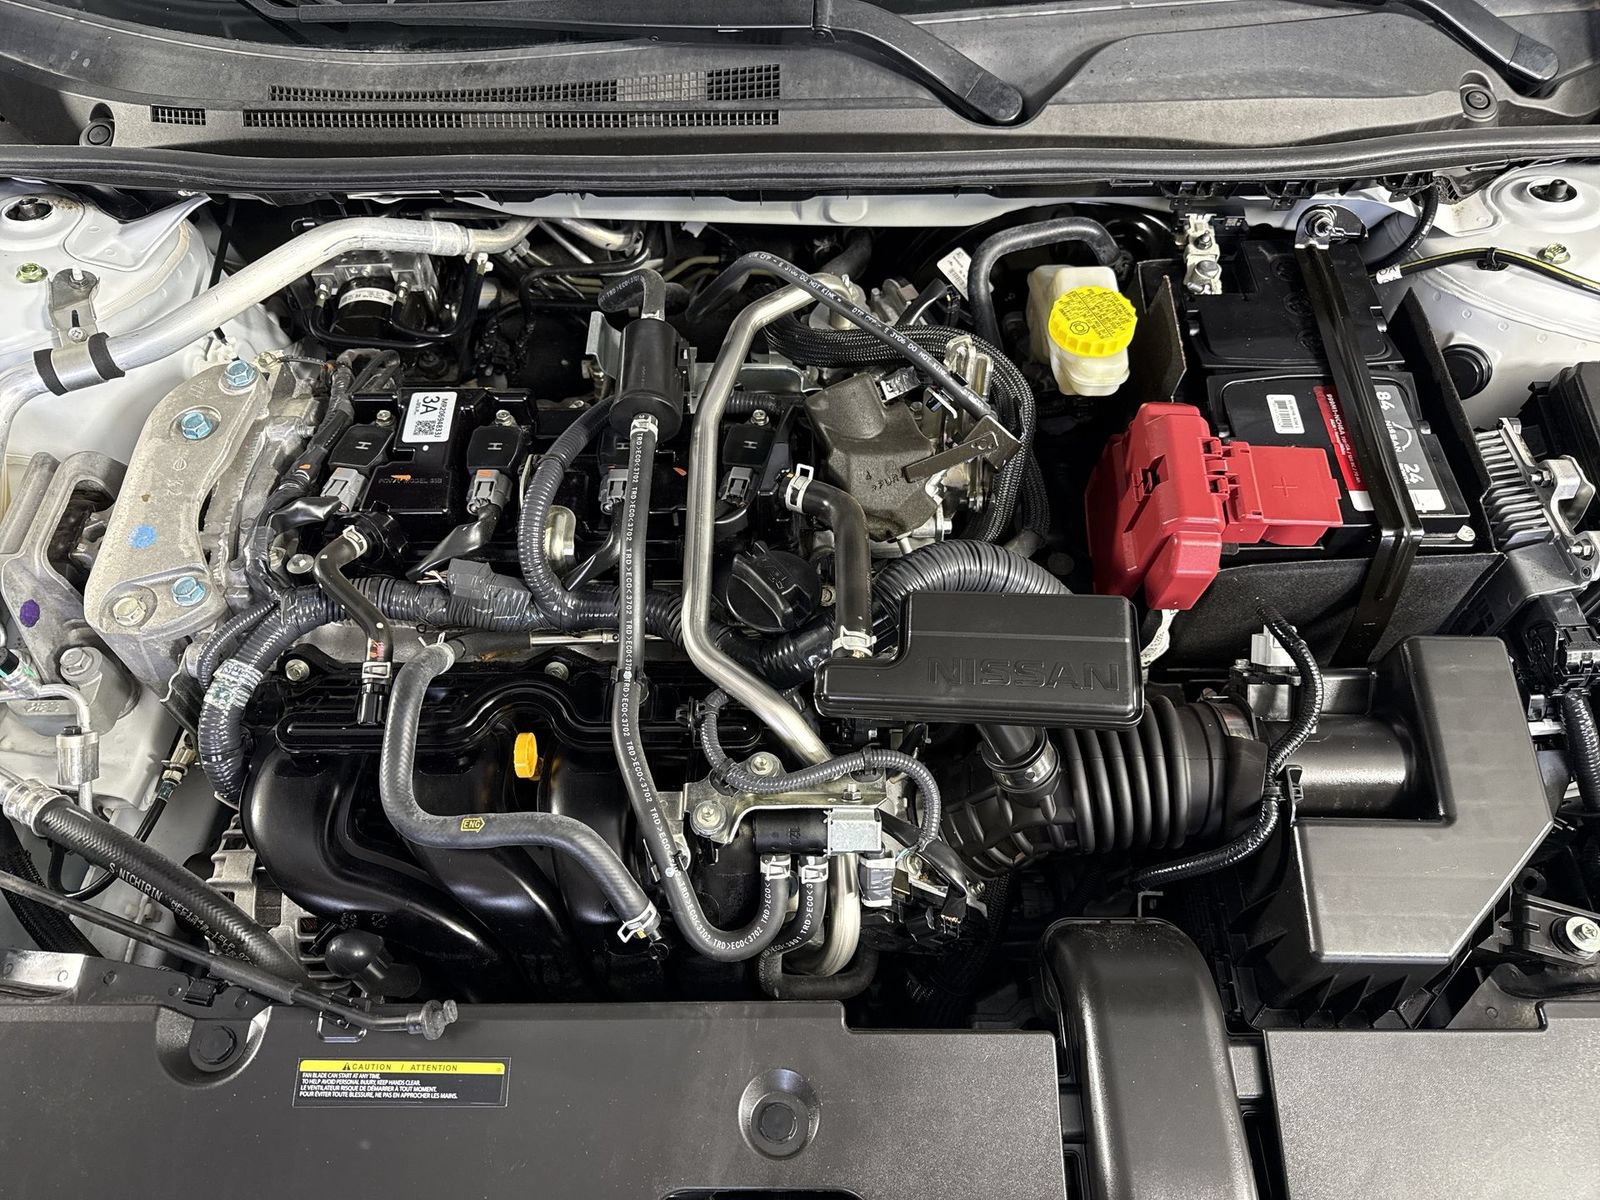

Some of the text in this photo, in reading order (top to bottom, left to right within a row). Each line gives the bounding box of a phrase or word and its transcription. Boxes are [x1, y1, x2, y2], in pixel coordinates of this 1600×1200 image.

[809, 280, 821, 290] NOT
[820, 287, 836, 300] KINK
[907, 343, 918, 352] DO
[919, 351, 931, 363] NOT
[420, 395, 440, 415] 3A
[1376, 391, 1395, 410] 84
[1385, 420, 1402, 453] NISSAN
[633, 433, 643, 483] TRD>ECO<3702
[1404, 463, 1425, 484] 24
[626, 487, 638, 541] TRD>ECO<3702
[625, 619, 633, 671] TRD>ECO<370
[927, 656, 1121, 692] NISSAN
[621, 679, 631, 737] TRD>ECO<3702
[626, 741, 653, 803] TRD>ECO<3702
[463, 820, 481, 829] ENG
[800, 883, 813, 935] TRD>ECO<3
[713, 926, 764, 950] TRD>ECO<3702
[352, 1063, 391, 1071] CAUTION
[410, 1064, 458, 1072] ATTENTION
